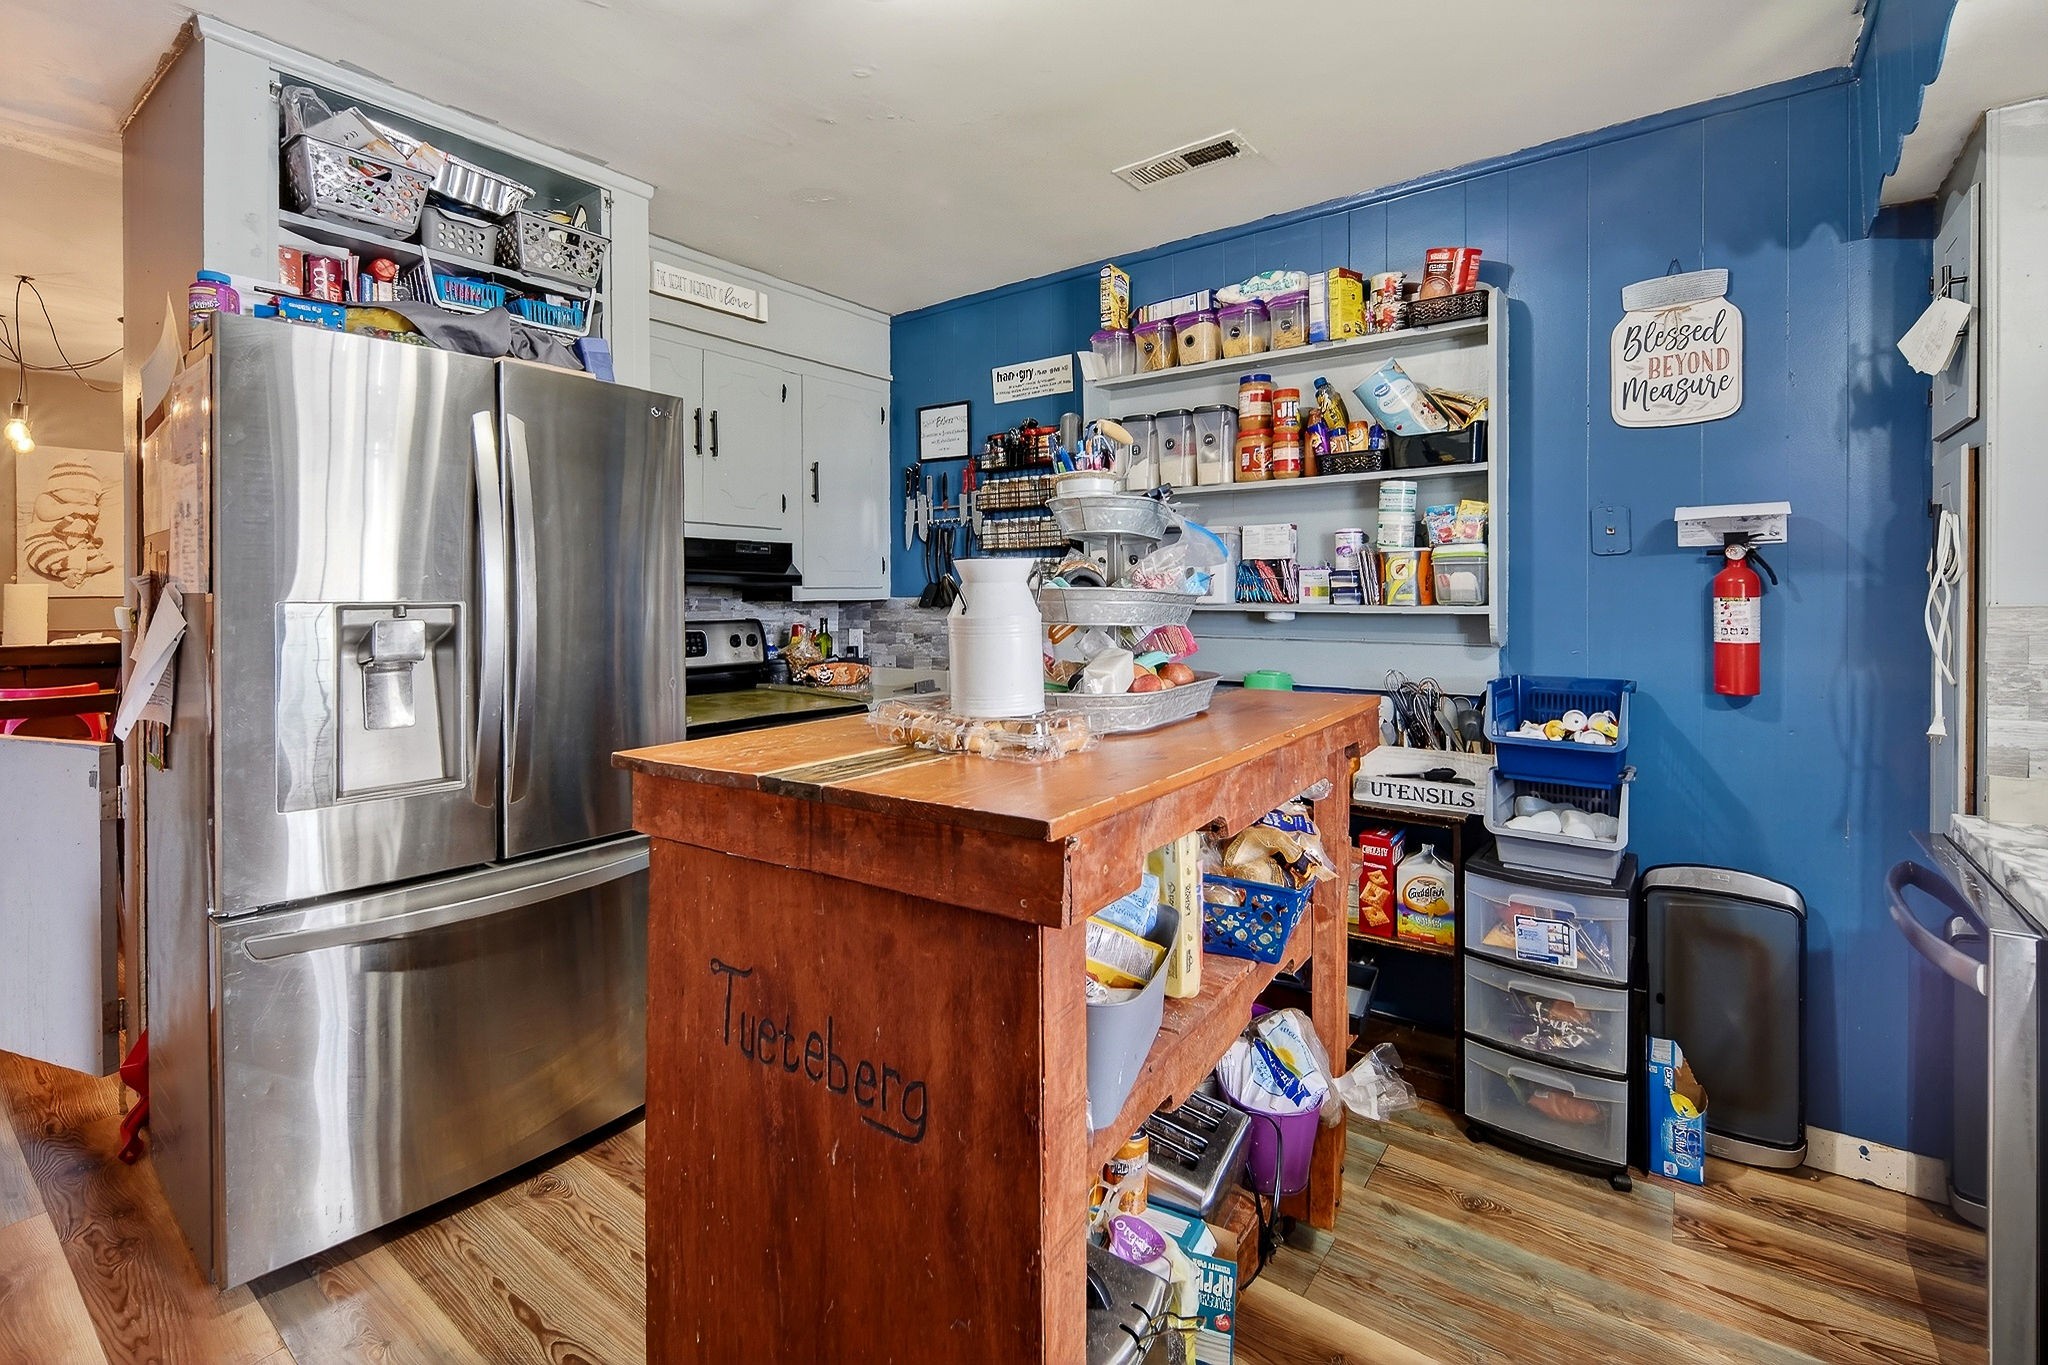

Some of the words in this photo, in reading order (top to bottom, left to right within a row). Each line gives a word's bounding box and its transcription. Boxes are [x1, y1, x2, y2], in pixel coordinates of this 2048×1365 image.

[1623, 308, 1728, 362] Blessed
[1648, 347, 1730, 380] BEYOND
[1622, 373, 1734, 412] Measure
[1371, 781, 1476, 808] UTENSILS
